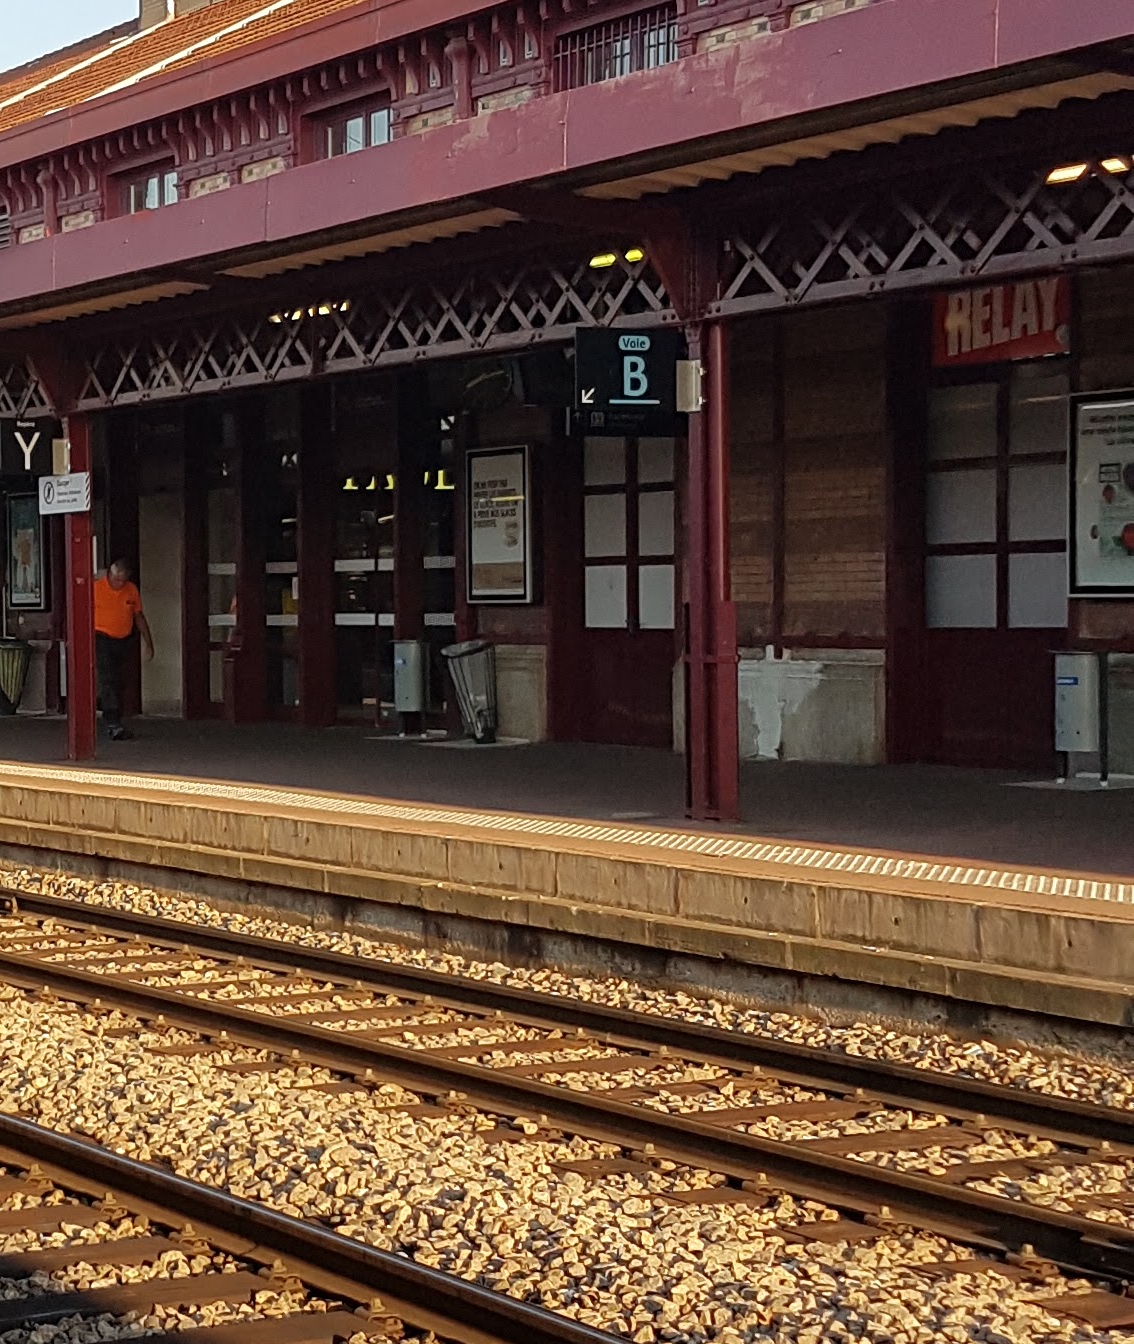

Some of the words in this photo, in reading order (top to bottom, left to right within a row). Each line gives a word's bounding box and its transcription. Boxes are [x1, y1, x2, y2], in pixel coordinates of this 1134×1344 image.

[946, 276, 1060, 357] RELAY
[622, 337, 646, 349] Voie
[623, 355, 648, 397] B
[13, 431, 41, 470] Y
